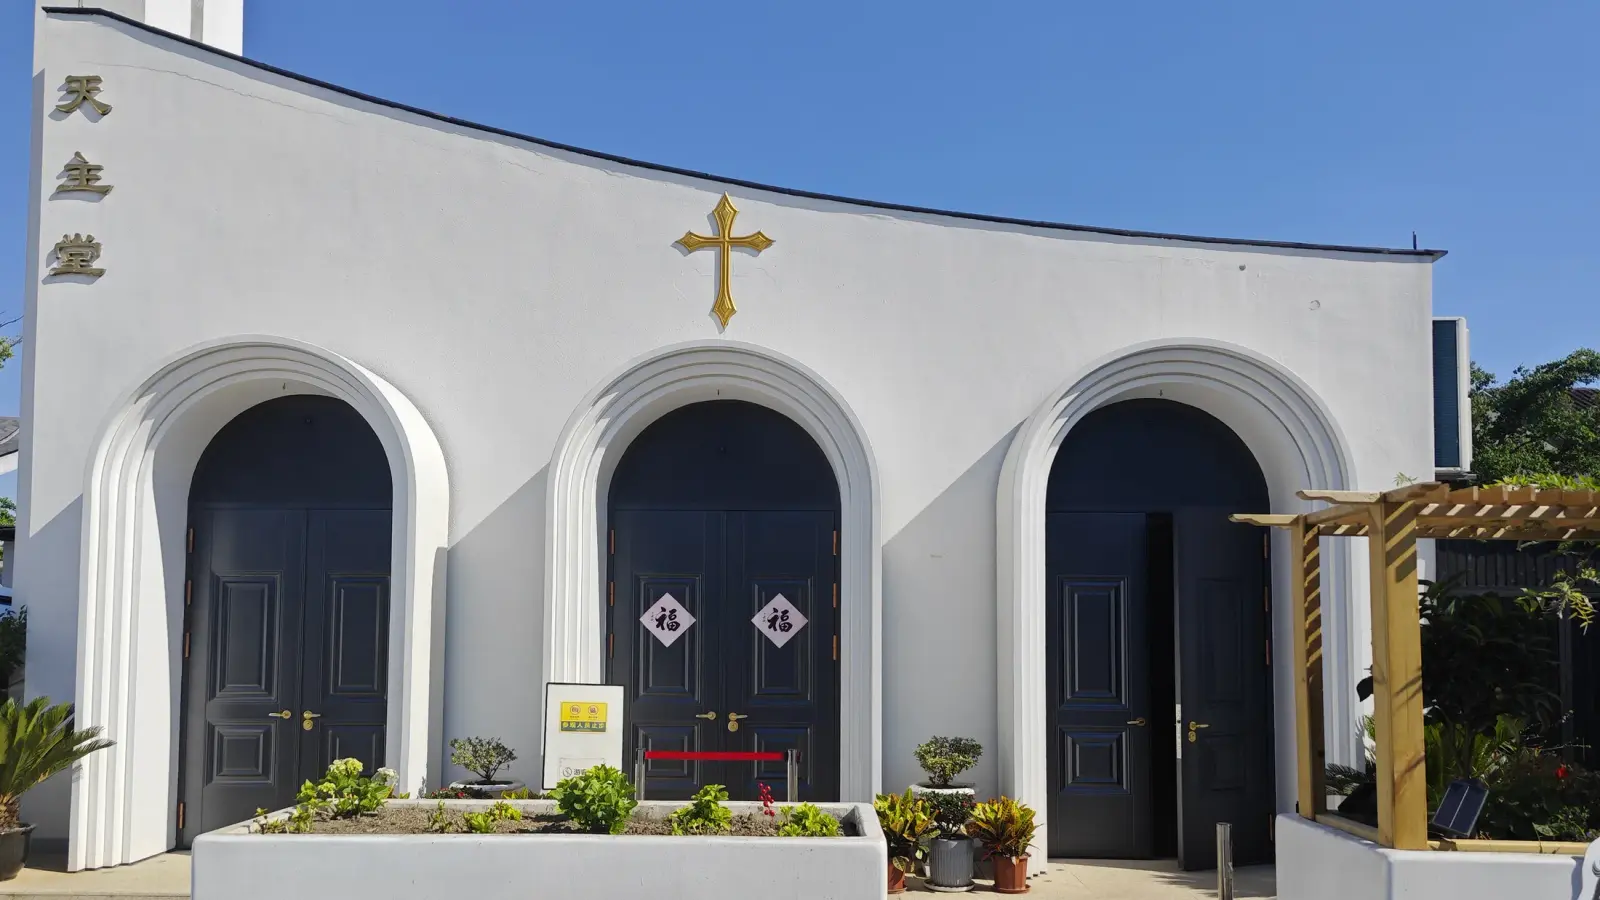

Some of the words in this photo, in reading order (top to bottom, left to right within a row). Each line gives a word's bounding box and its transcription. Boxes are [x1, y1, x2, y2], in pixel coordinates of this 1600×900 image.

[49, 74, 114, 277] 天主堂
[655, 606, 681, 632] 福
[767, 607, 793, 633] 福
